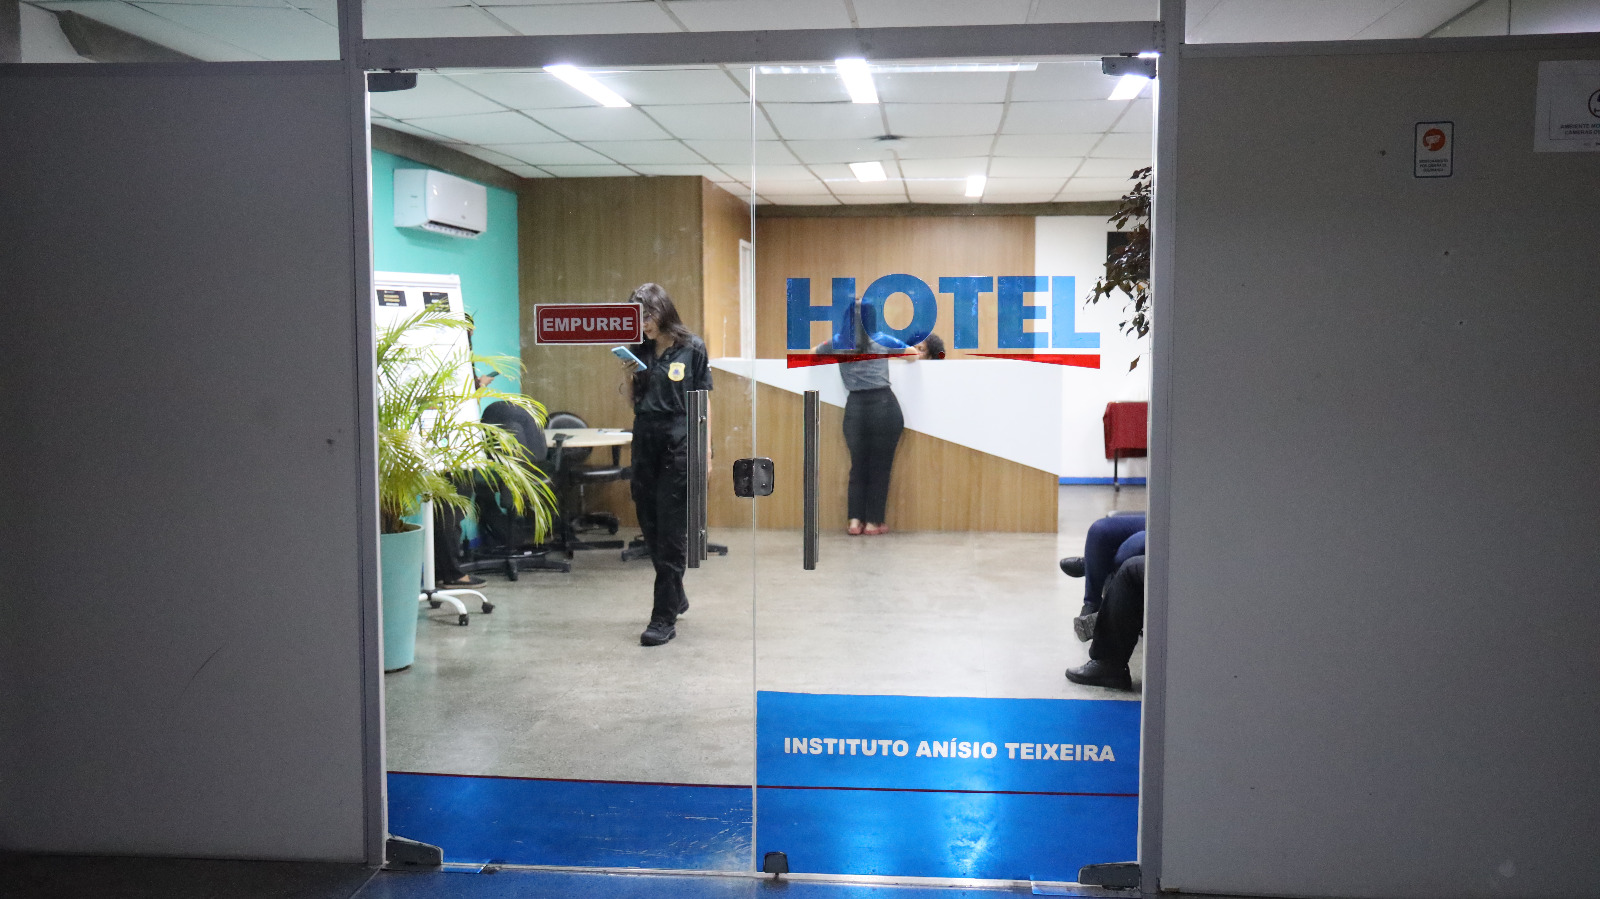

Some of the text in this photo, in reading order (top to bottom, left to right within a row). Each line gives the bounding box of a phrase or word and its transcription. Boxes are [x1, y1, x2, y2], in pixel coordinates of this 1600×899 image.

[543, 316, 634, 332] EMPURRE
[786, 273, 1100, 350] HOTEL
[784, 737, 1115, 762] INSTITUTO ANÍSIO TEIXEIRA
